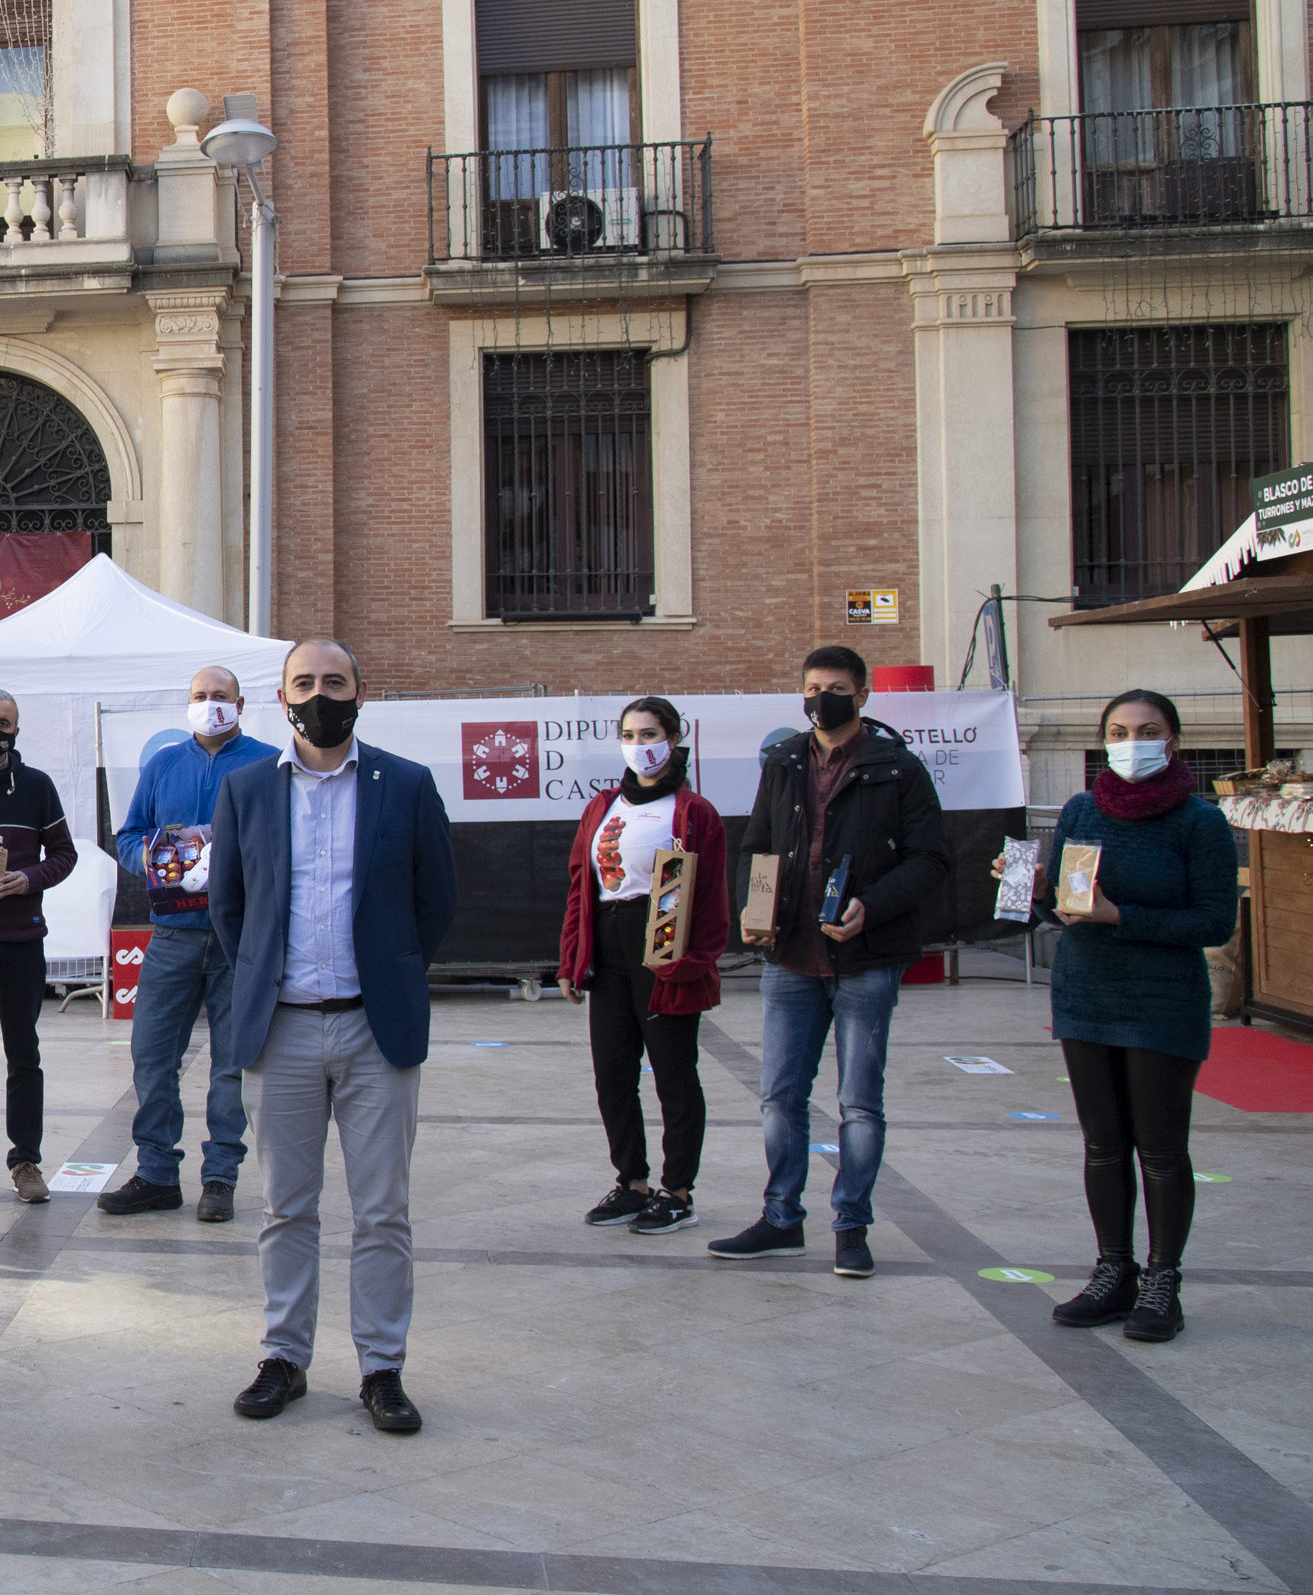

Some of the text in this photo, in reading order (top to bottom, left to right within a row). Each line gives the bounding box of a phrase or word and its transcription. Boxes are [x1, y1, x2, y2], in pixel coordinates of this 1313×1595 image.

[1263, 479, 1300, 502] BLASCO
[1258, 500, 1295, 520] TURRONES
[1295, 499, 1301, 511] Y
[544, 751, 564, 770] D
[935, 749, 959, 765] DE
